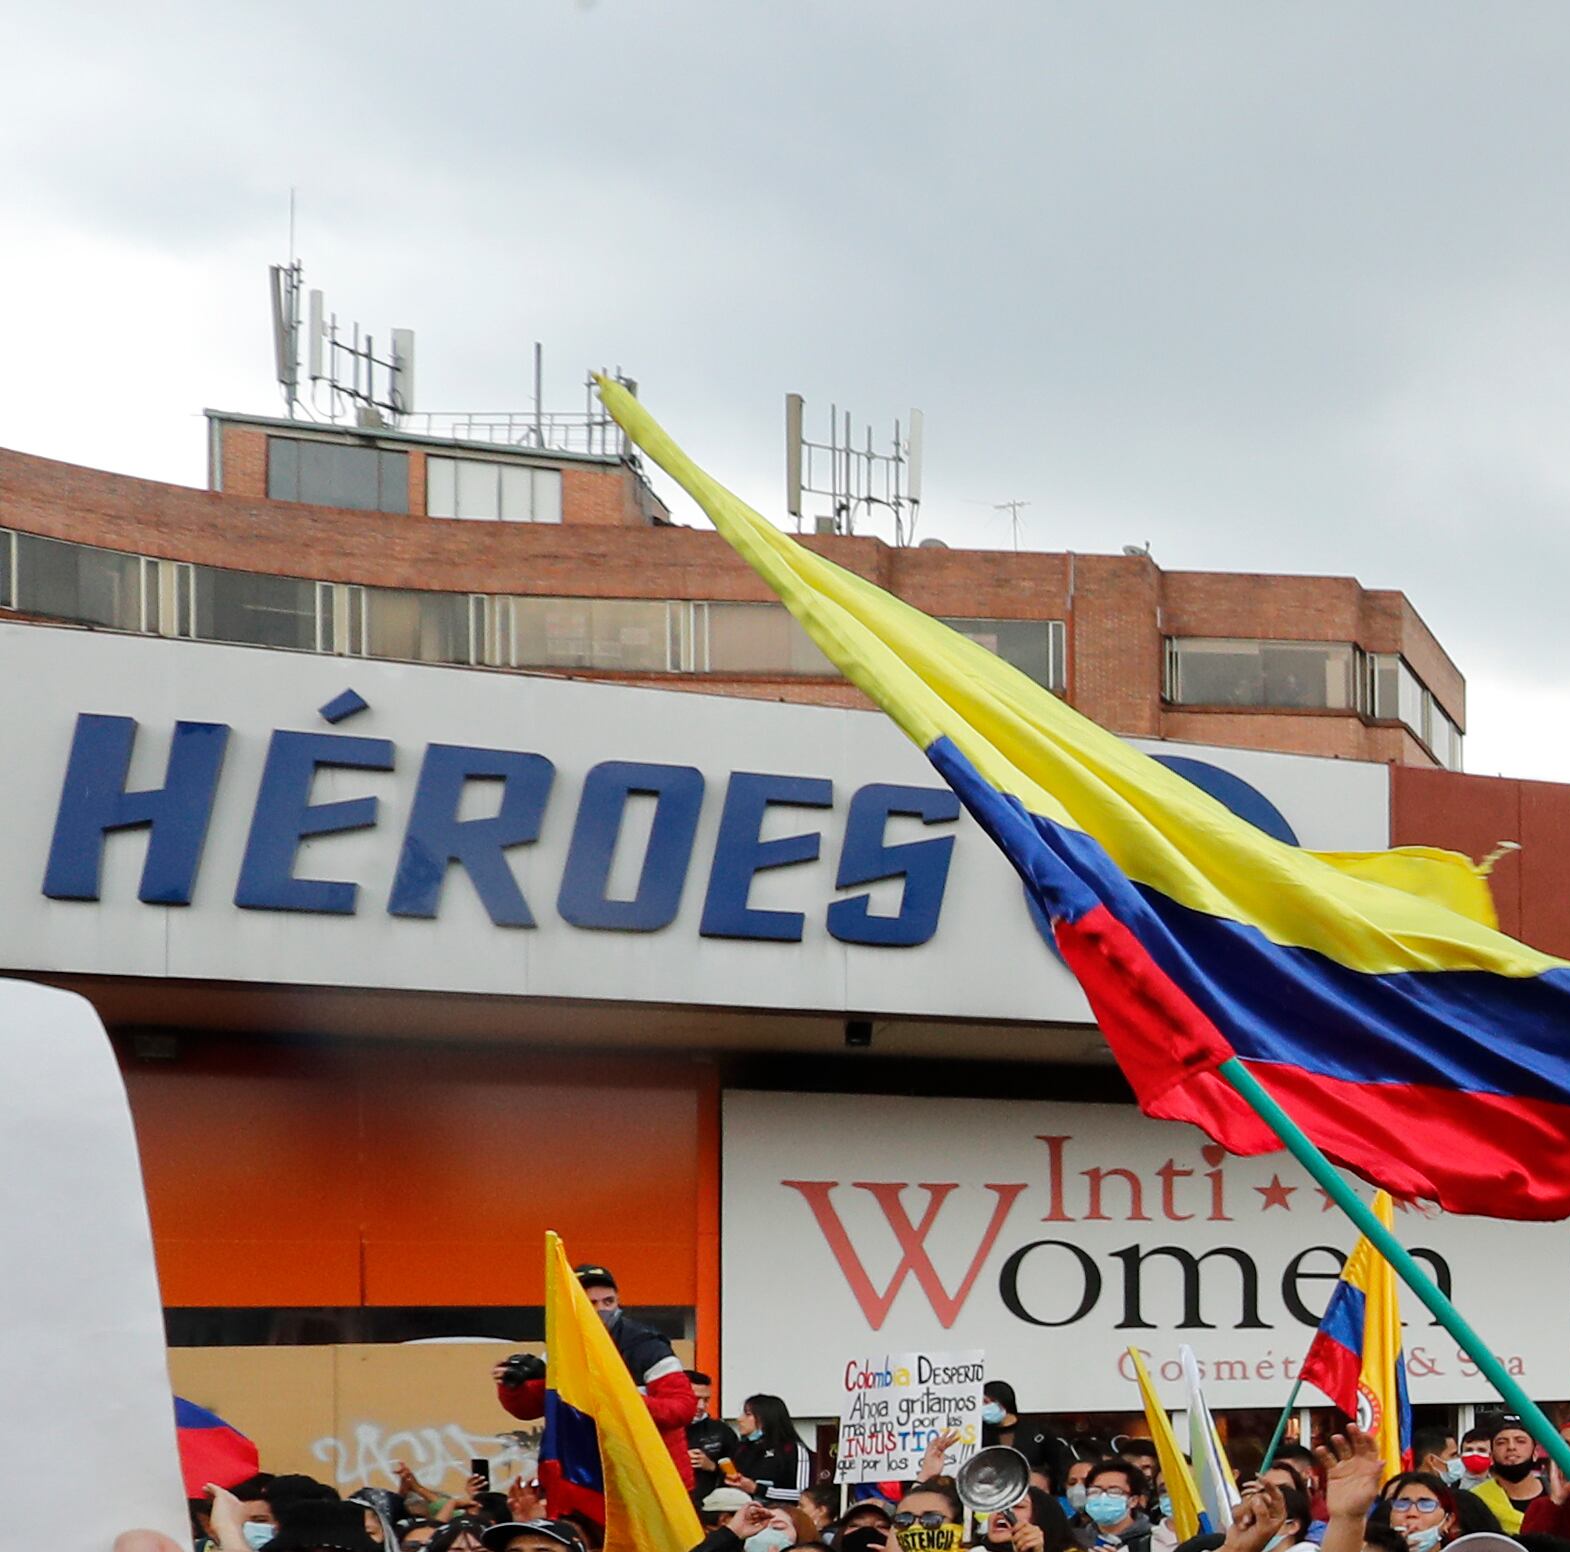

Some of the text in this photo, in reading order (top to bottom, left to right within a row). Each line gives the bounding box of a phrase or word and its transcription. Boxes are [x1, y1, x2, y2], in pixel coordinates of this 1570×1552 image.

[41, 688, 961, 947] HÉROES
[1035, 1135, 1232, 1222] Inti
[845, 1356, 910, 1392] Colombia
[1119, 1349, 1298, 1382] Cosmét
[897, 1387, 976, 1426] gritamos
[912, 1417, 937, 1434] por
[946, 1413, 962, 1427] las
[862, 1458, 881, 1482] por
[887, 1453, 908, 1470] los
